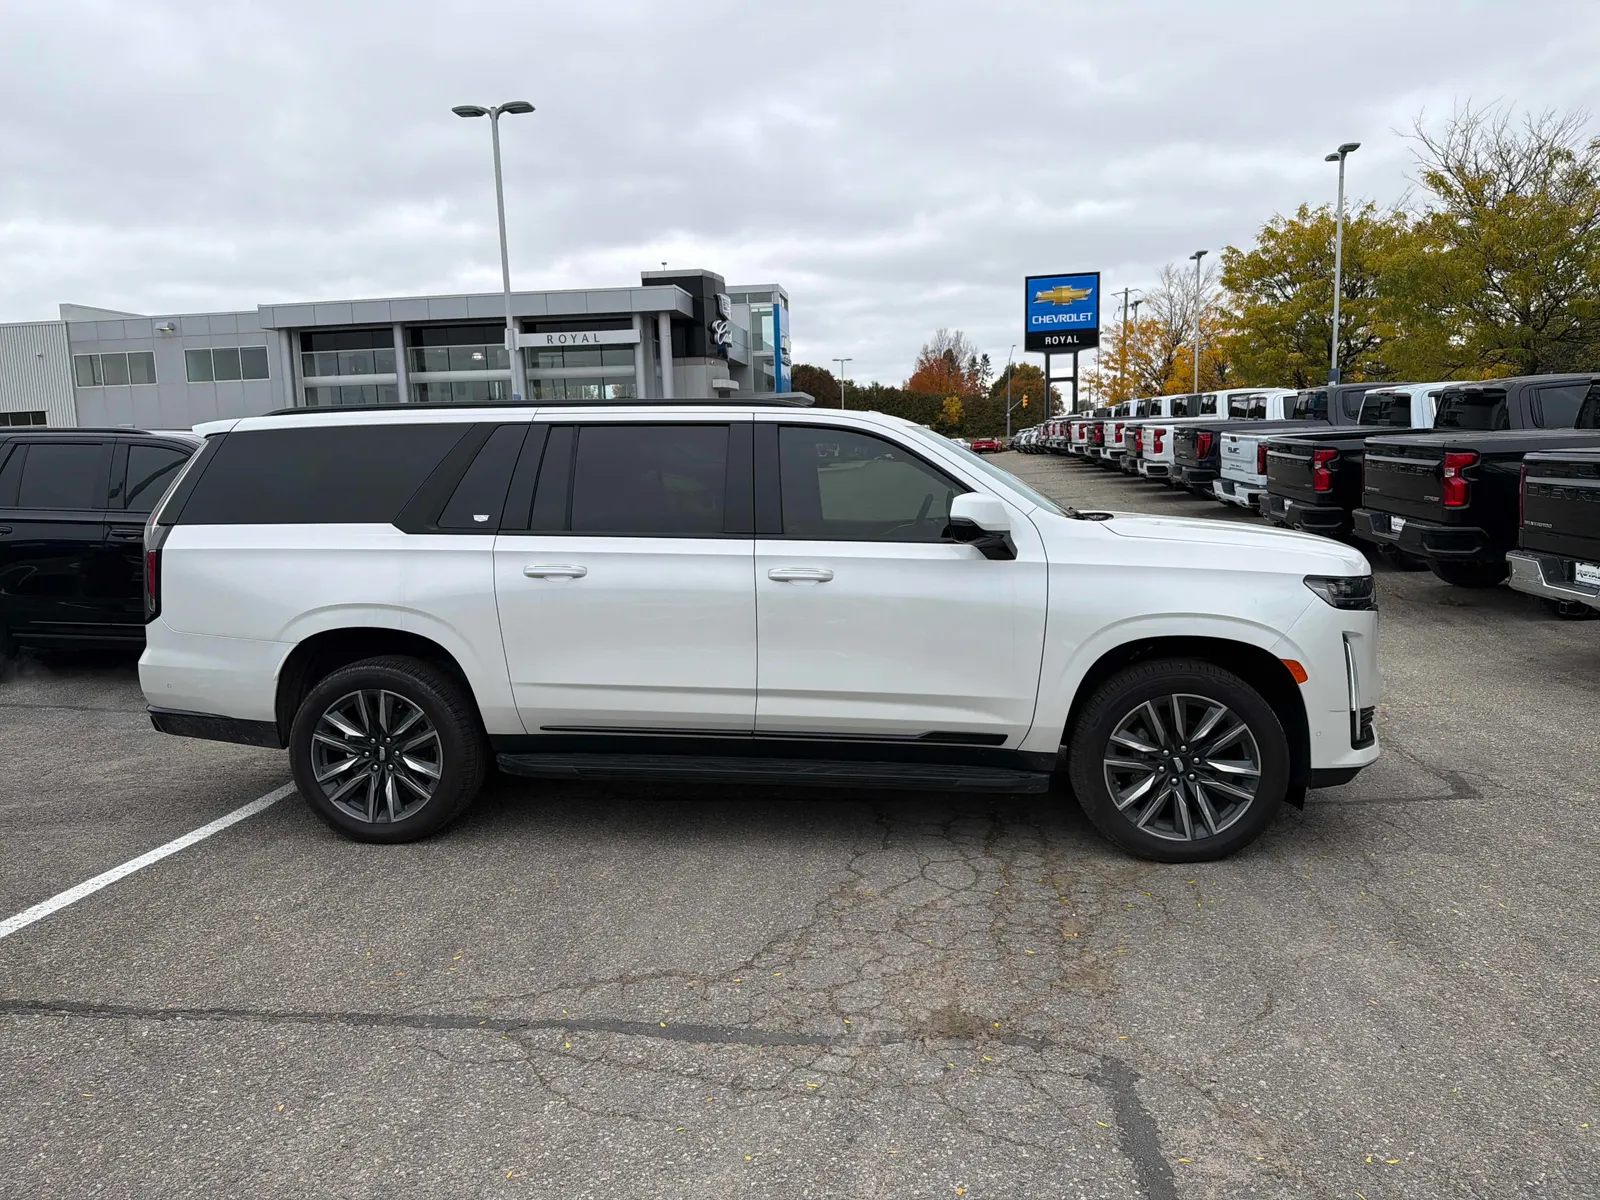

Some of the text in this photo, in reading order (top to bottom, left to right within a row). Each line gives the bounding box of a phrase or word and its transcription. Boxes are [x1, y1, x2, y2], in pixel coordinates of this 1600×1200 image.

[1032, 312, 1093, 324] CHEVROLET
[546, 333, 600, 344] ROYAL
[1045, 335, 1079, 345] ROYAL
